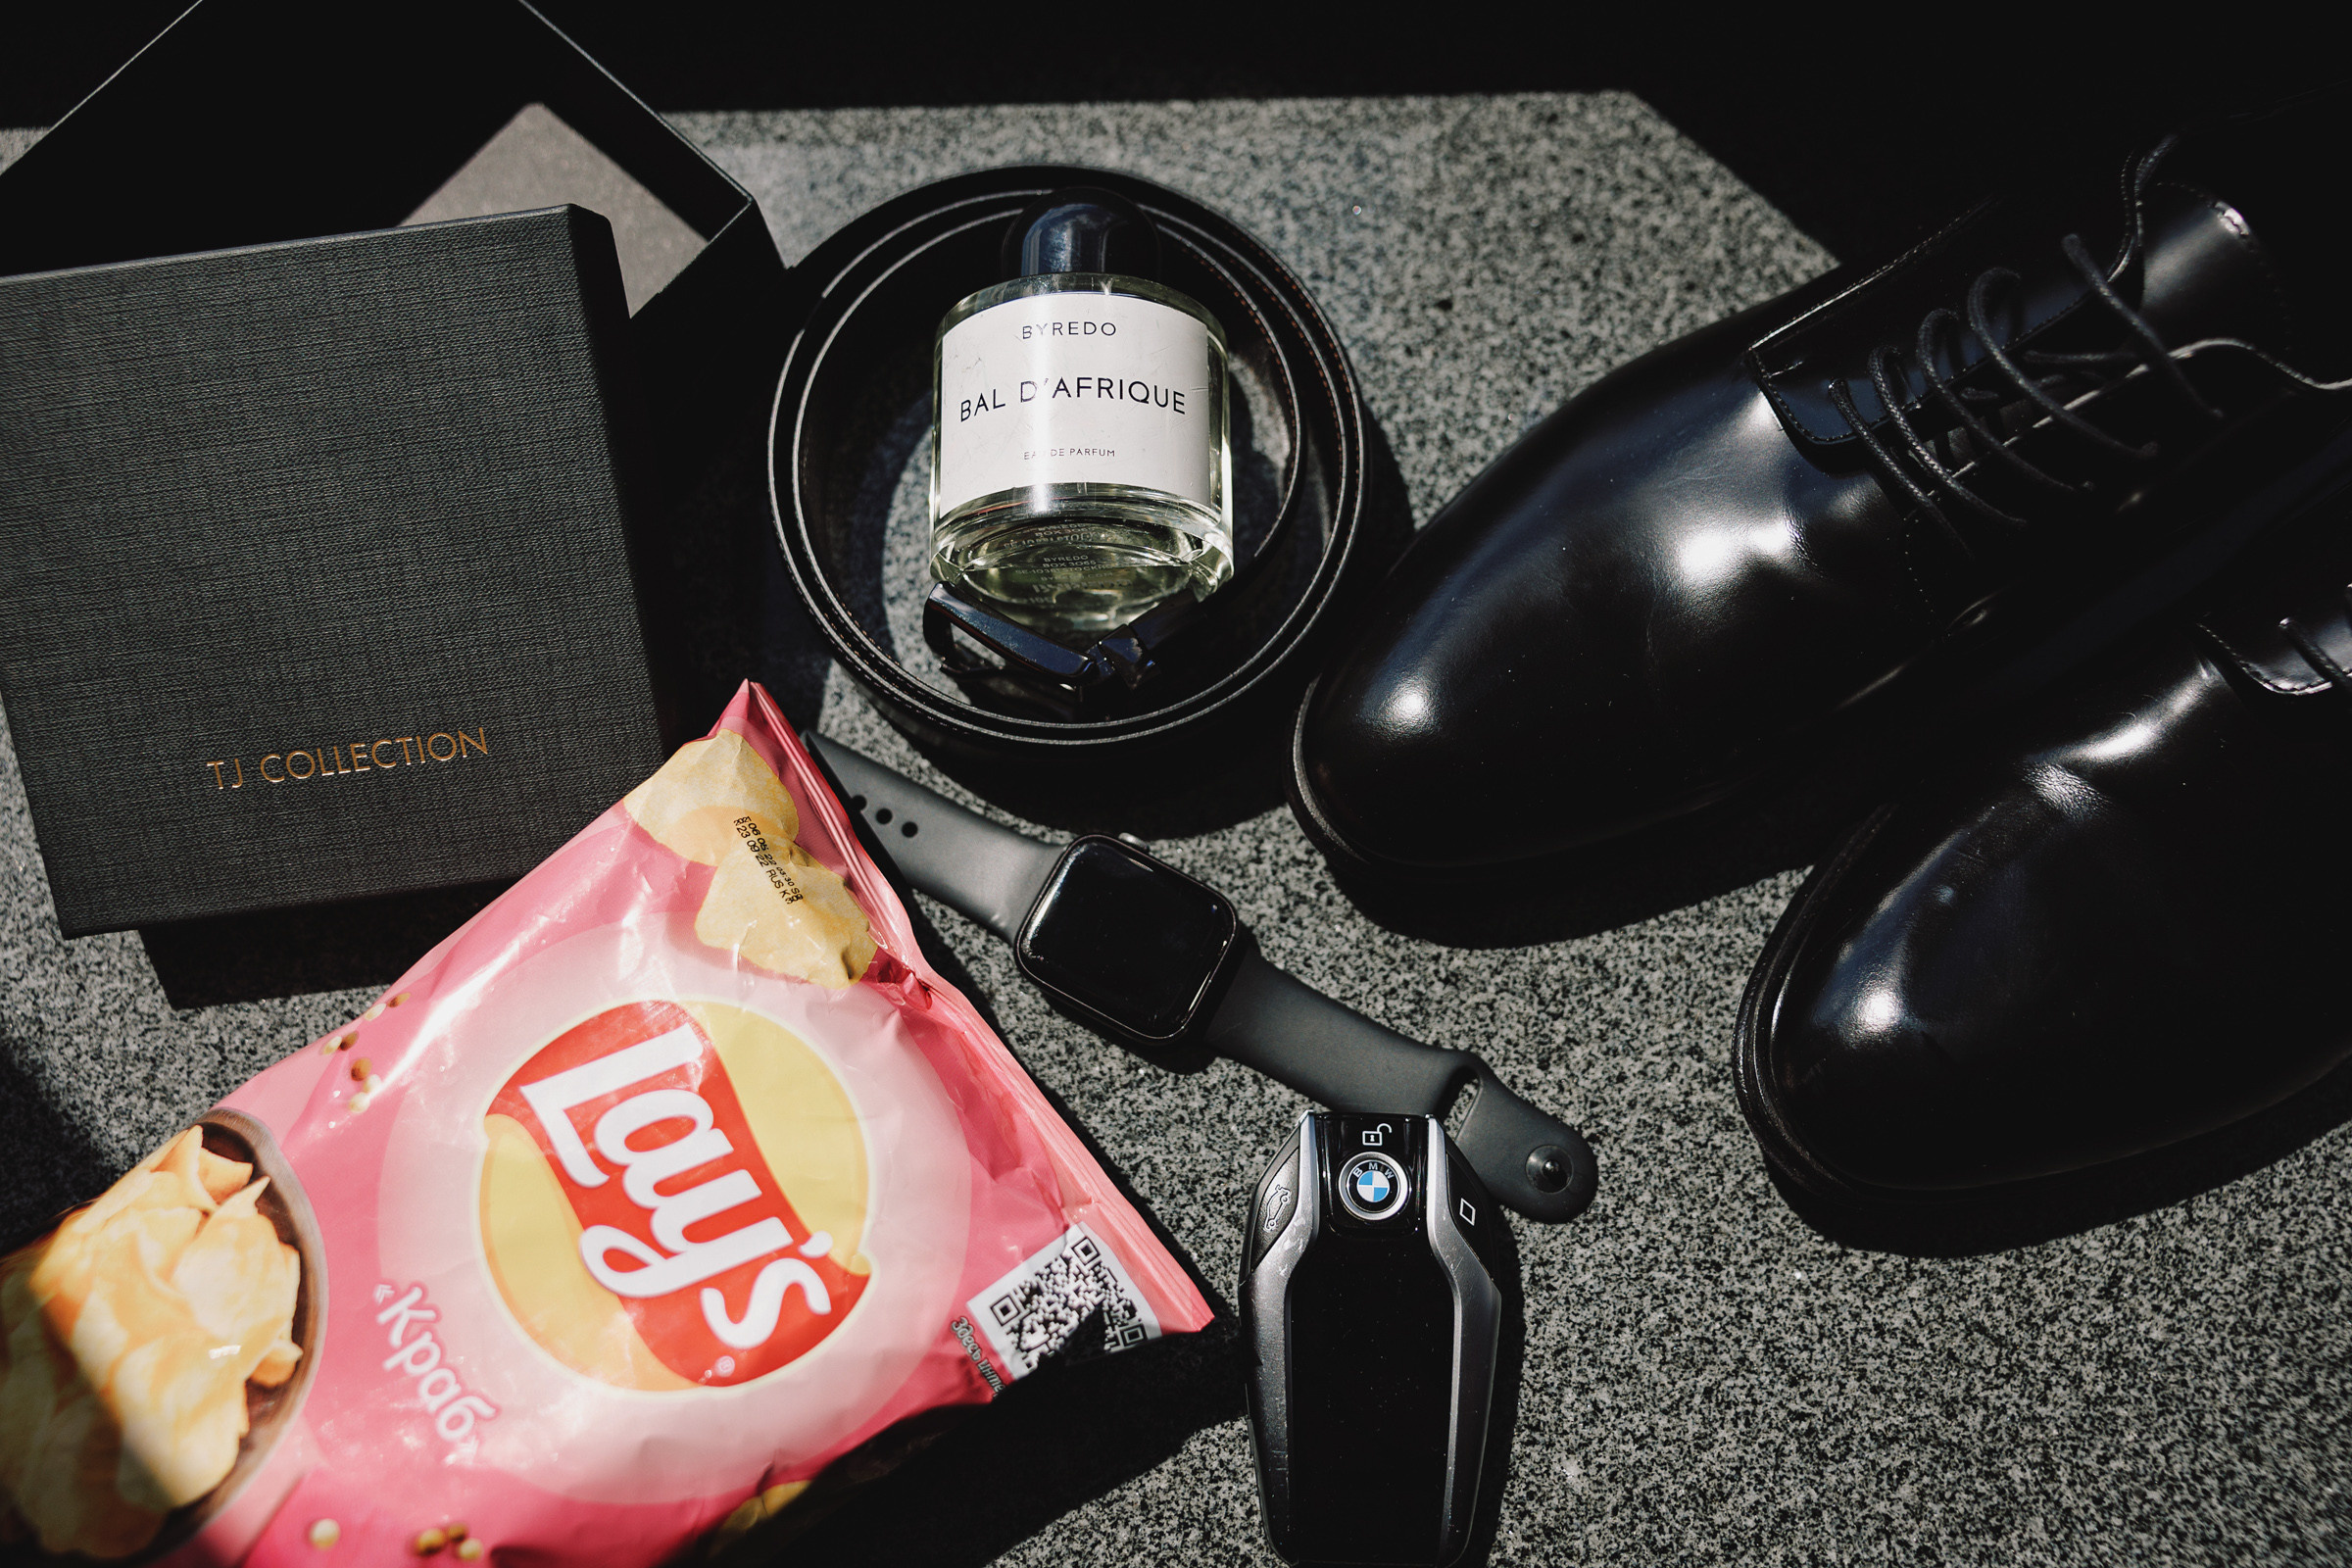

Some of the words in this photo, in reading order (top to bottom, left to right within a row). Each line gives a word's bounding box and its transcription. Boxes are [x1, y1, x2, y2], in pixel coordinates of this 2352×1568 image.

[1022, 321, 1116, 339] BYREDO
[960, 388, 1005, 422] BAL
[1020, 376, 1186, 415] D'AFRIQUE
[1051, 448, 1065, 457] DE
[1069, 448, 1115, 457] PARFUM
[206, 758, 244, 790] TJ
[260, 726, 489, 783] COLLECTION
[736, 825, 751, 839] 23
[746, 839, 760, 853] 09
[755, 855, 769, 867] 22
[765, 868, 784, 889] RUS
[779, 889, 791, 899] K
[763, 854, 777, 865] 22
[517, 1021, 834, 1350] Lay's
[1352, 1161, 1395, 1179] BMW
[951, 1315, 983, 1362] Здесь
[976, 1357, 1005, 1397] инте
